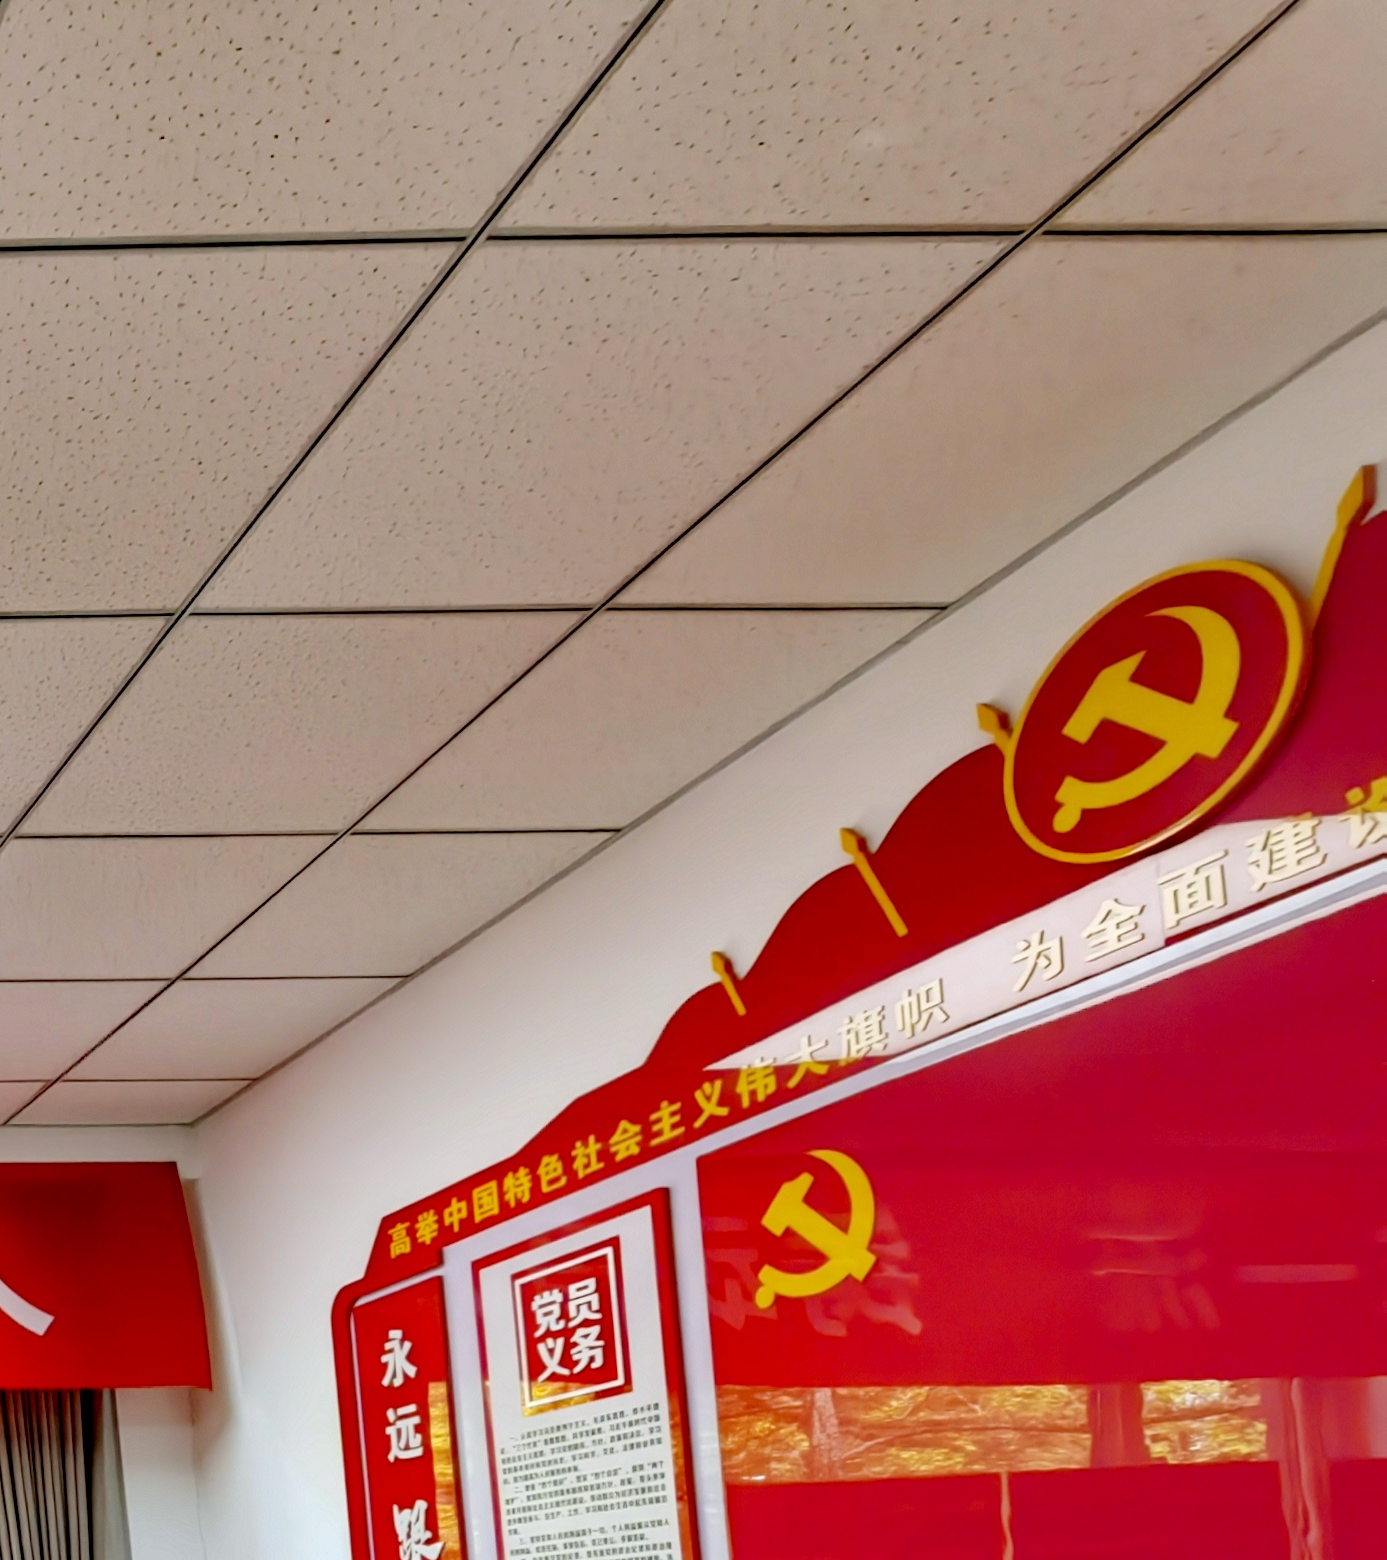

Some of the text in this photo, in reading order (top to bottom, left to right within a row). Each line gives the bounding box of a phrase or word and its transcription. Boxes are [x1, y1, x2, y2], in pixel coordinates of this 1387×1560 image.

[387, 978, 949, 1259] 高举中国特色社会主义伟大旗帜
[531, 1277, 603, 1338] 党员
[537, 1325, 606, 1383] 义务
